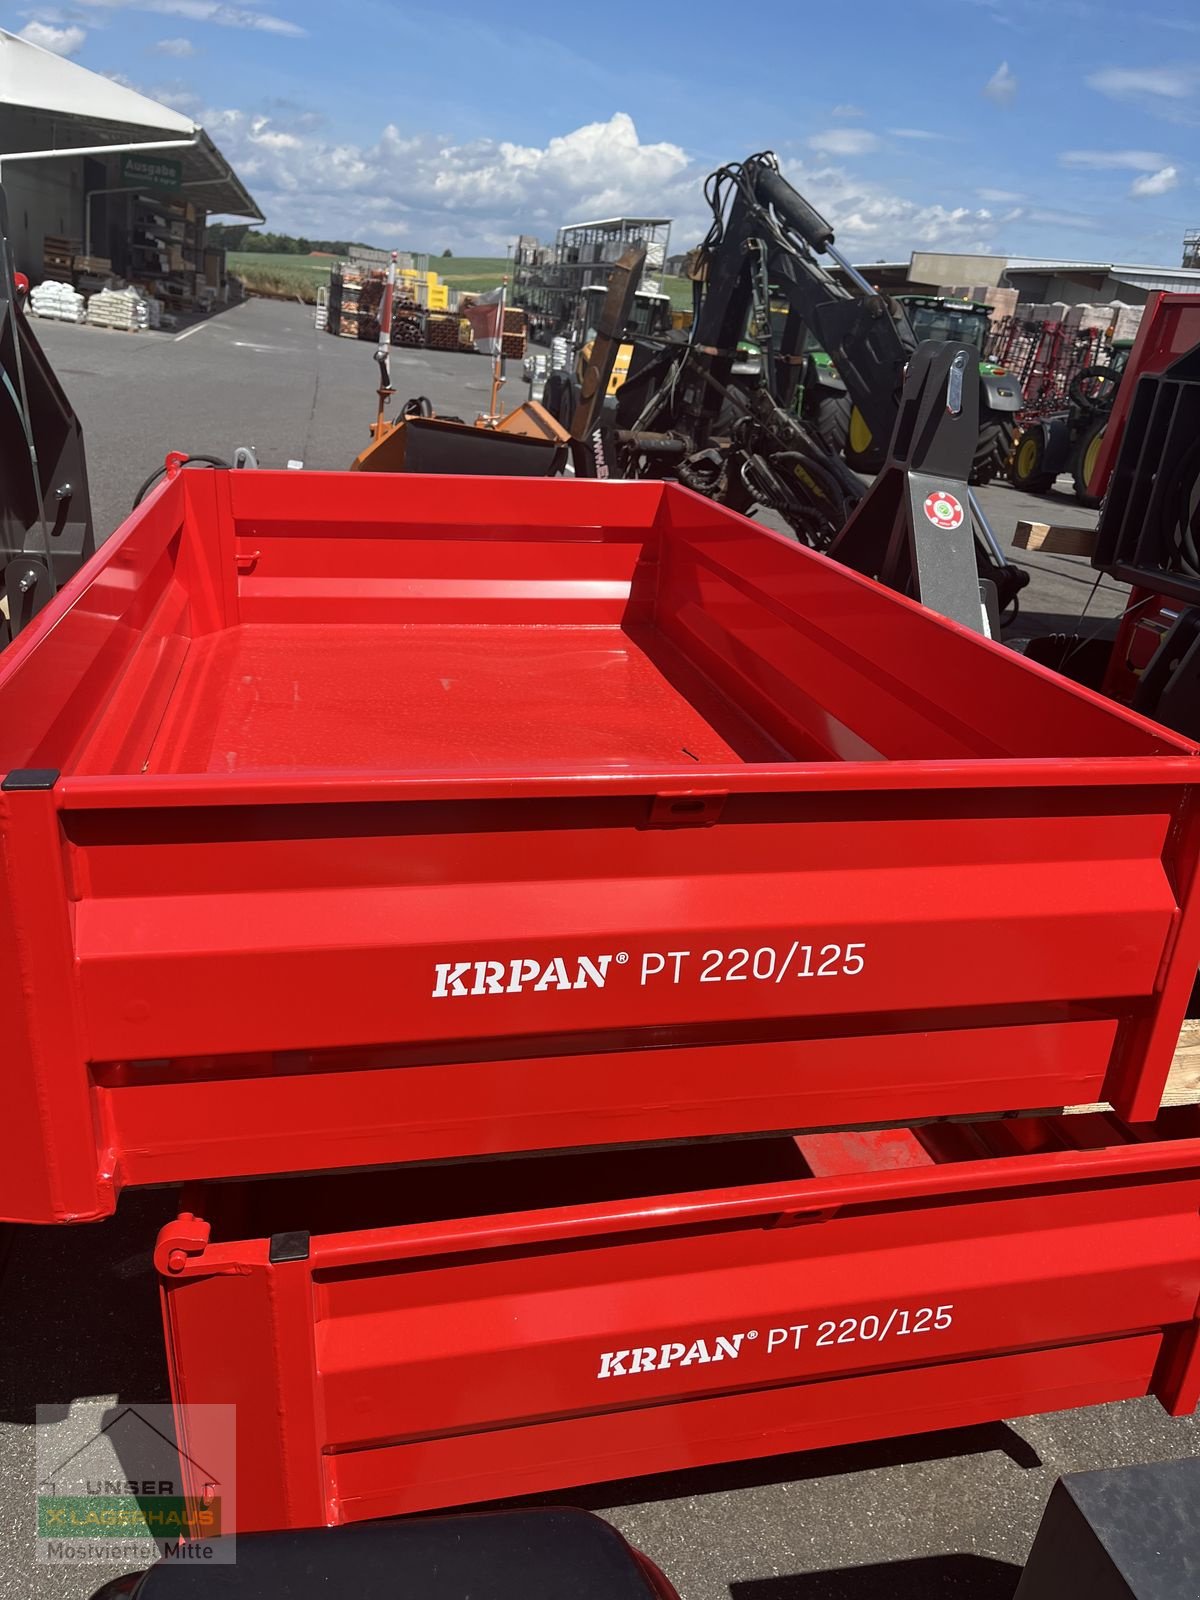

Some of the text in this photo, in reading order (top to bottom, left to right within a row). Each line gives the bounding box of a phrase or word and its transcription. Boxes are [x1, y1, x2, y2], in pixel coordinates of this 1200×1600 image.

[125, 159, 176, 177] Ausgabe
[641, 948, 690, 985] PT
[700, 942, 865, 982] 220/125
[768, 1325, 808, 1353] PT
[816, 1305, 953, 1346] 220/125
